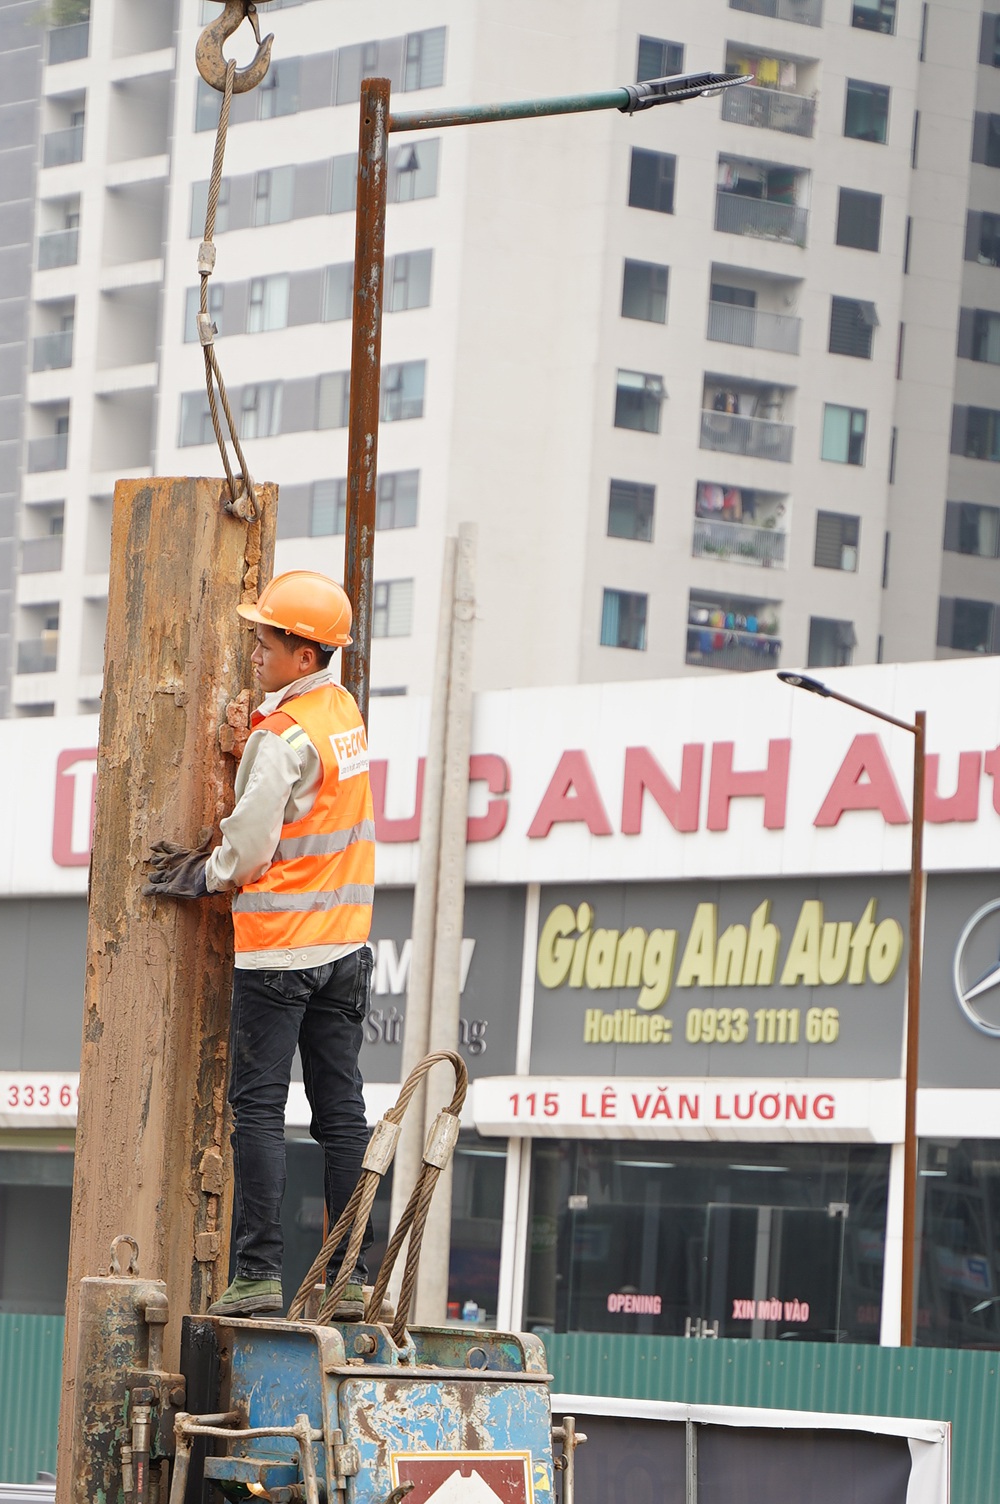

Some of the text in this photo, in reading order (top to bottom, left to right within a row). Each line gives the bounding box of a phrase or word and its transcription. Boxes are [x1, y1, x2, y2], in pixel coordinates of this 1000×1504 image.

[527, 738, 791, 838] ANH
[537, 902, 677, 1010] Giang
[676, 898, 780, 986] Anh
[780, 897, 904, 985] Auto
[584, 1007, 840, 1044] Hotline: 0933 1111 66
[8, 1085, 51, 1106] 333
[59, 1085, 79, 1106] 6
[509, 1086, 835, 1120] 115 LÊ VĂN LƯƠNG
[607, 1293, 662, 1315] OPENING
[732, 1299, 755, 1320] XIN
[784, 1298, 810, 1322] VÀO
